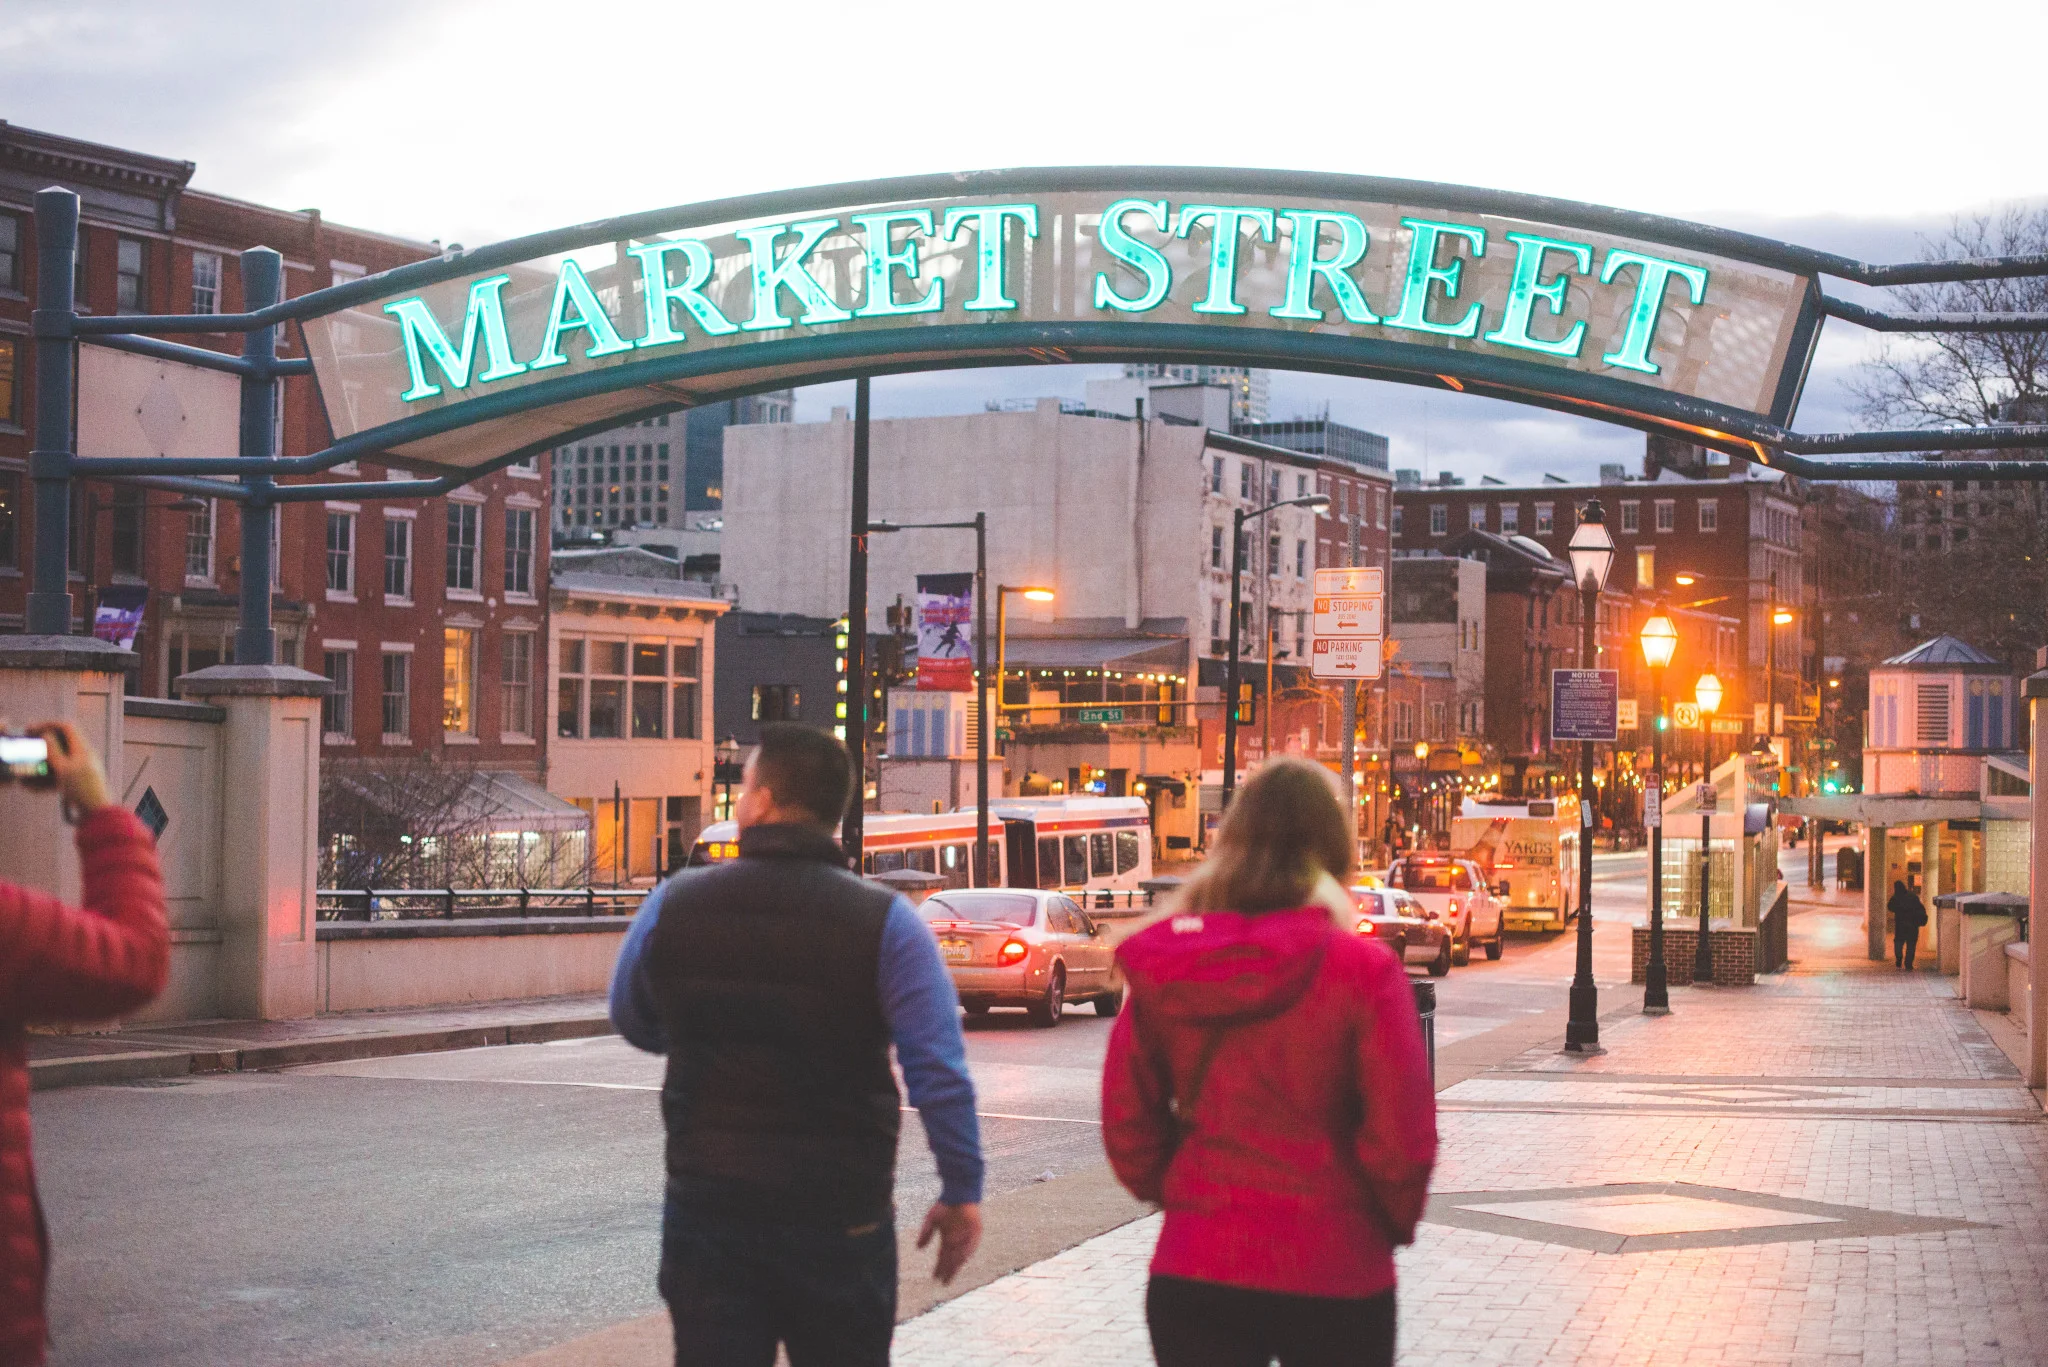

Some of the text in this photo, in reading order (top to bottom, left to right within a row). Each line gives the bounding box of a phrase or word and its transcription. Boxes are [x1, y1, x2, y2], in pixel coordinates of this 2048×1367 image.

[383, 198, 1708, 402] MARKET STREET
[1317, 599, 1373, 612] NO STOPPING
[1316, 641, 1363, 653] NO PARKING
[1083, 710, 1119, 721] 2nd St
[1505, 841, 1552, 854] YARDS
